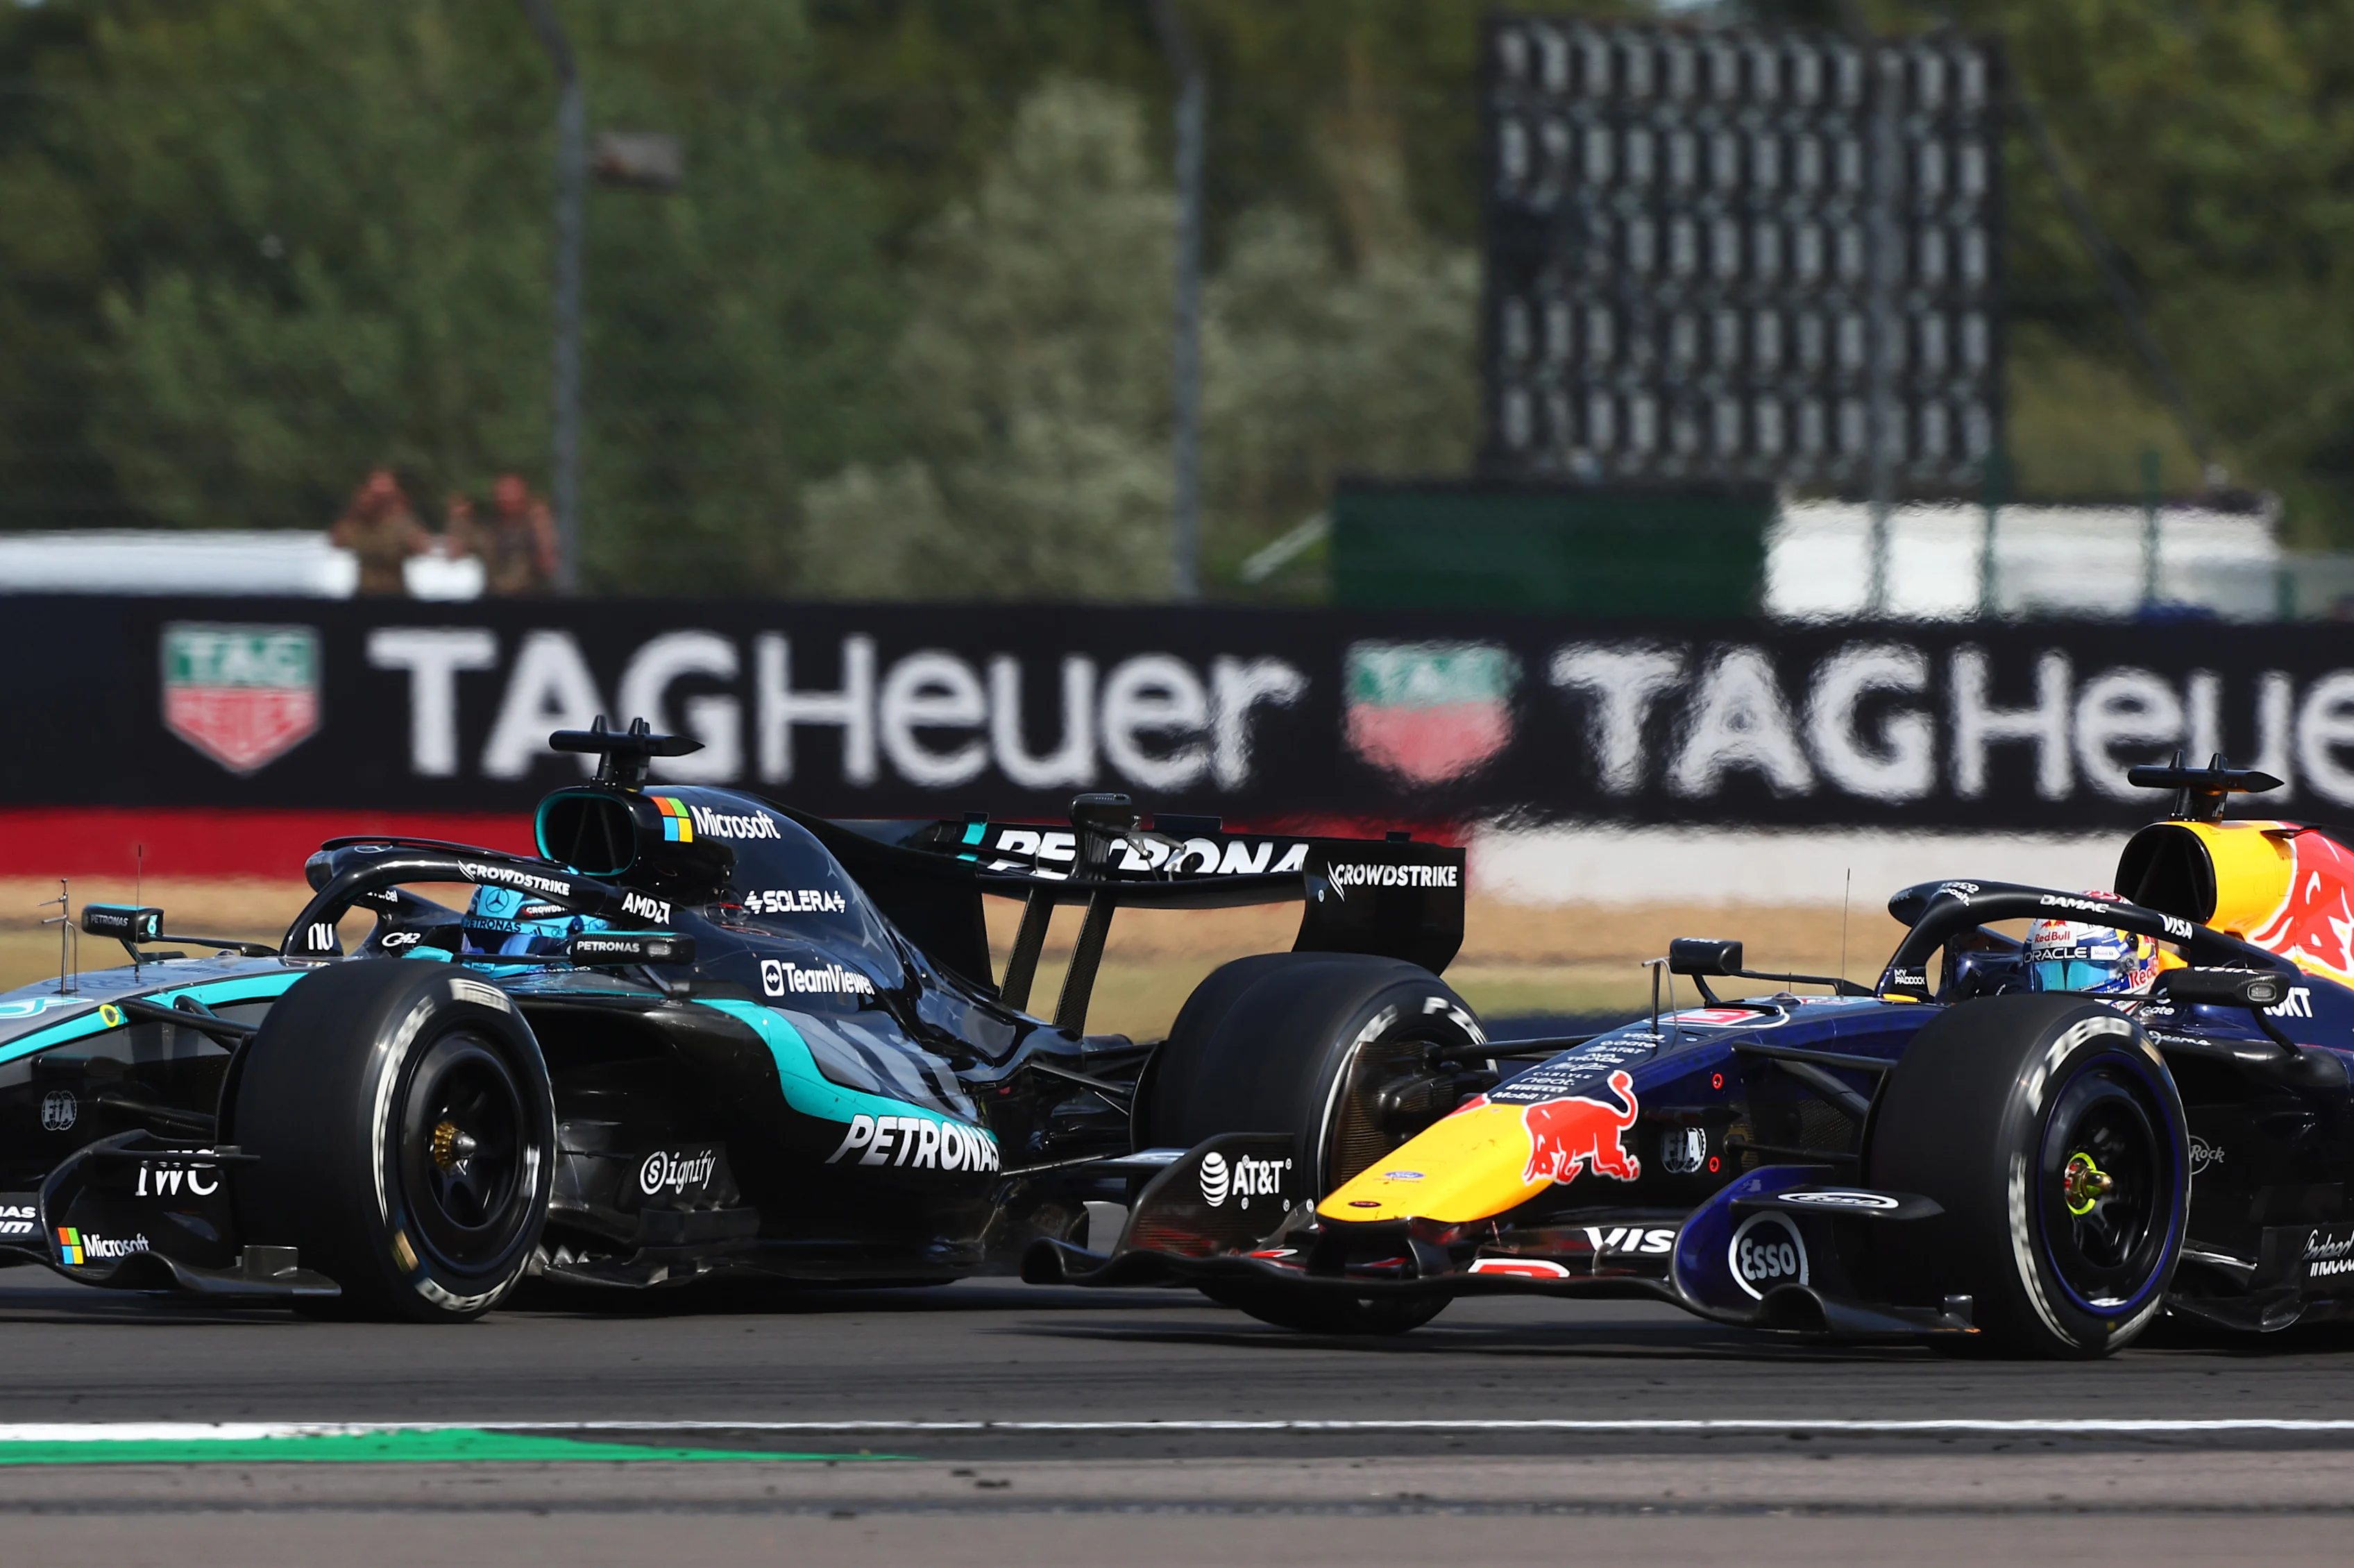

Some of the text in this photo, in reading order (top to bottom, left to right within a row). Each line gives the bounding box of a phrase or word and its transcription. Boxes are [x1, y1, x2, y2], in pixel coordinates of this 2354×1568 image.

[690, 806, 781, 840] Microsoft
[466, 863, 570, 896] CROWDSTRIKE
[1335, 864, 1457, 887] CROWDSTRIKE
[621, 892, 657, 919] AMD
[763, 890, 838, 913] SOLERA
[2040, 894, 2110, 914] DAMAC
[90, 913, 129, 928] PETRONAS
[2158, 913, 2194, 939] VISA
[577, 941, 641, 953] PETRONAS
[2034, 930, 2071, 944] Red Bull
[2024, 946, 2088, 963] ORACLE
[781, 962, 876, 996] TeamViewer
[1895, 976, 1925, 985] PADDOCK
[1491, 1091, 1538, 1100] Mobil
[824, 1114, 1000, 1172] PETRONAS
[2191, 1144, 2226, 1163] Rock
[1232, 1160, 1284, 1195] AT&T
[82, 1232, 149, 1257] Microsoft
